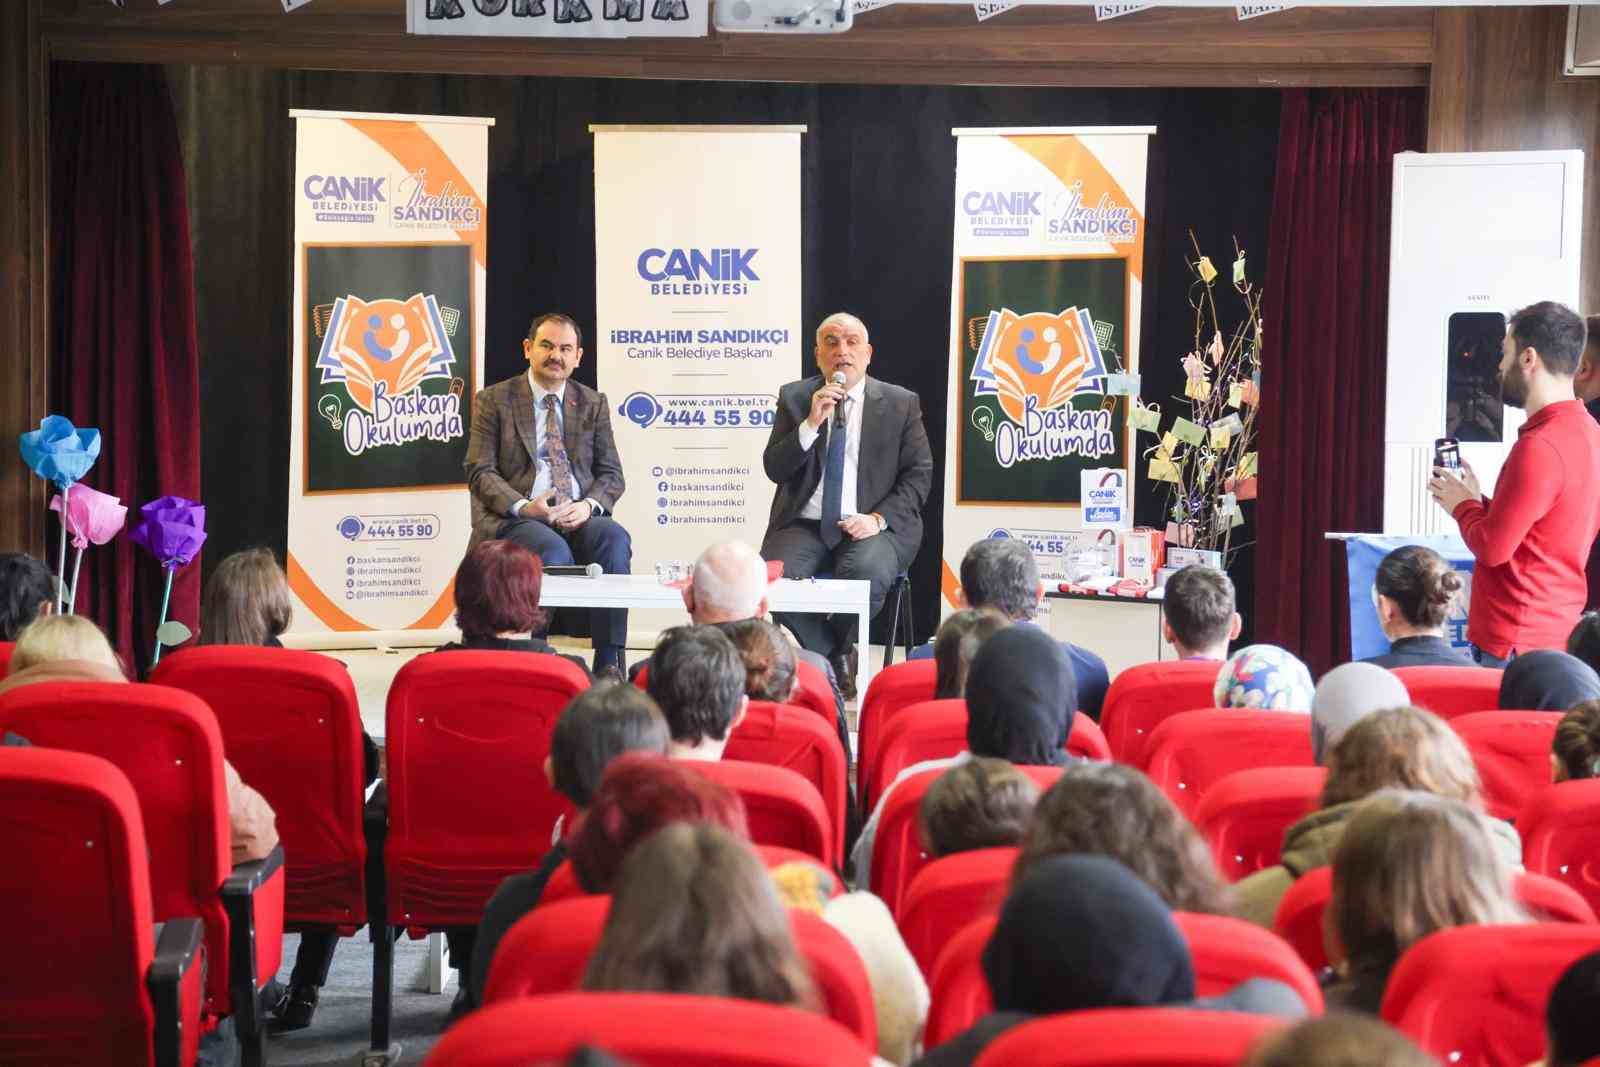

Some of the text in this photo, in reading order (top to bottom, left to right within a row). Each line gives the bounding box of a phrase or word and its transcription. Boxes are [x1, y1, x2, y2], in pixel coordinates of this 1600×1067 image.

[393, 207, 481, 224] SANDIKÇI
[1048, 219, 1137, 236] SANDIKÇI
[697, 329, 789, 345] SANDIKÇI
[627, 347, 773, 361] Canik Belediye Başkanı
[374, 382, 457, 423] Başkan
[669, 398, 769, 406] www.canik.bel.tr
[664, 410, 775, 425] 444 55 90
[1025, 396, 1109, 436] Başkan
[346, 410, 461, 452] Okulumda
[997, 421, 1113, 465] Okulumda
[665, 466, 750, 478] @ibrahimsandikci
[671, 482, 744, 492] baskansandikci
[670, 497, 745, 507] ibrahimsandikci
[670, 515, 745, 525] ibrahimsandikci
[367, 524, 433, 537] 444 55 90
[1047, 541, 1064, 553] 55
